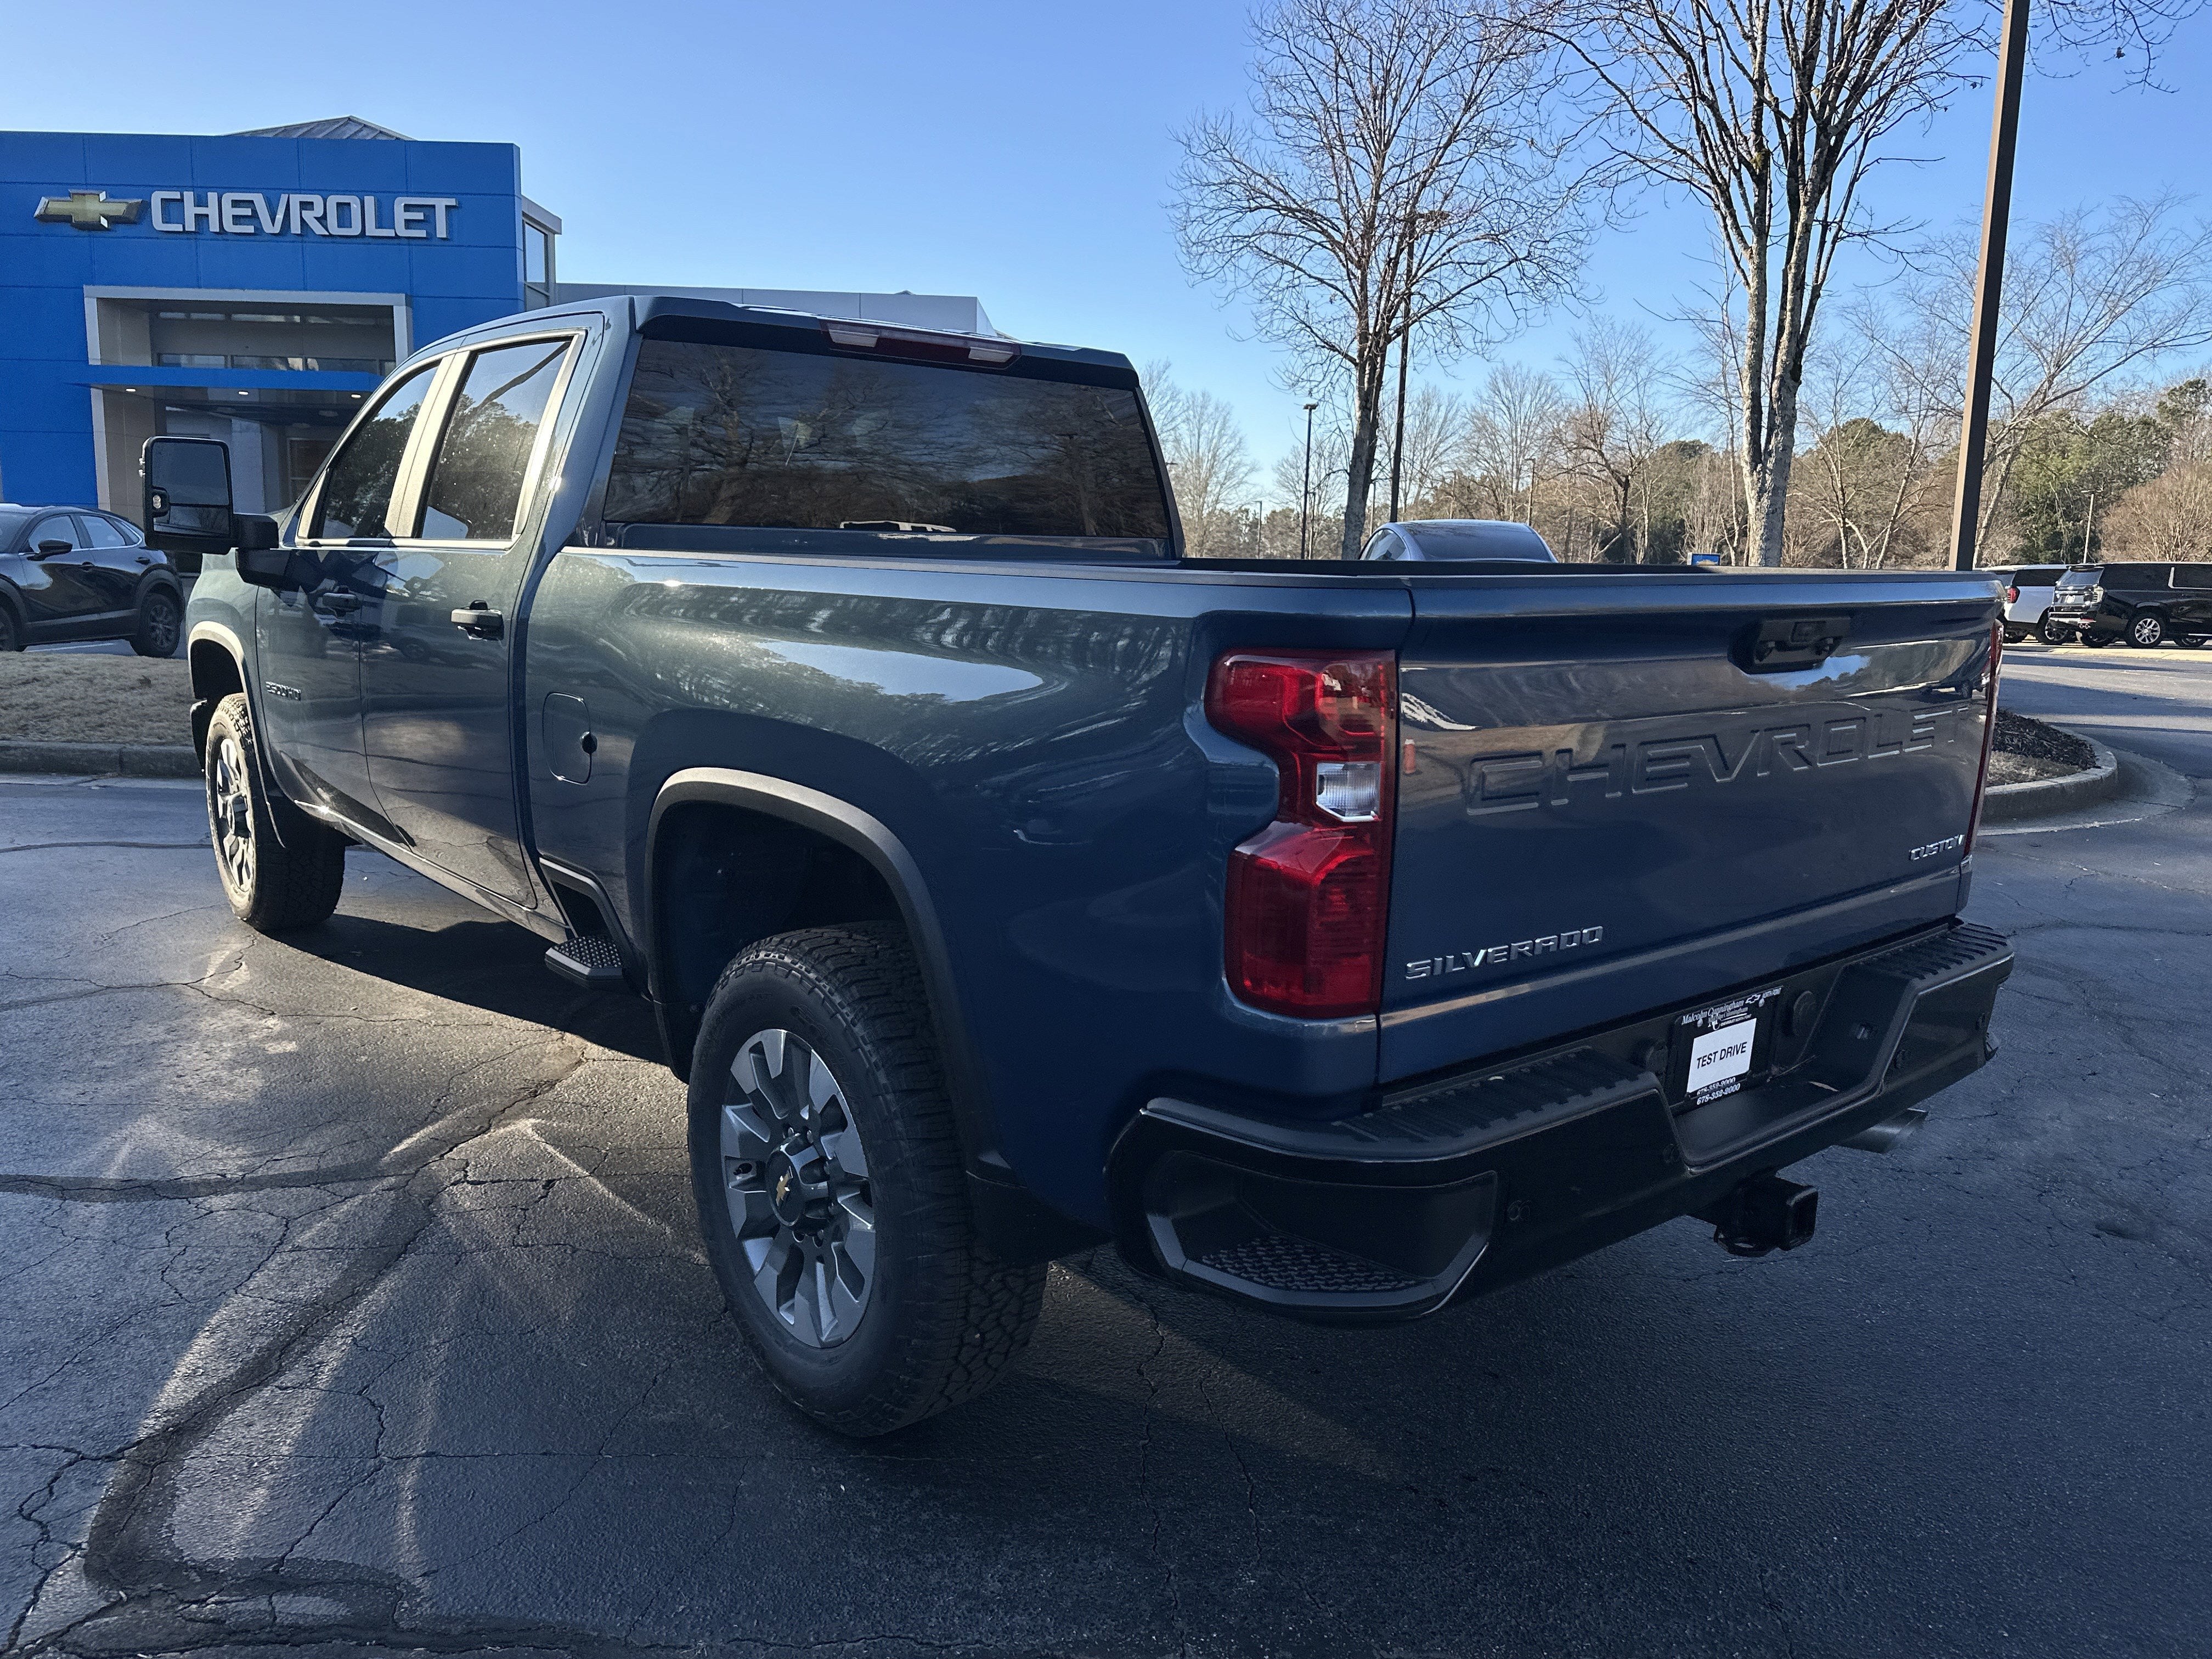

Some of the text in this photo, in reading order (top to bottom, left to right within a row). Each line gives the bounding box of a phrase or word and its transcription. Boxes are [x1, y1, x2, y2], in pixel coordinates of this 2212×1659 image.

[151, 190, 459, 238] CHEVROLET
[1466, 703, 1970, 816] CHEVROLET
[1406, 926, 1603, 980] SILVERADO
[1681, 1010, 1708, 1025] Malcolm
[1697, 1041, 1747, 1069] TEST DRIVE
